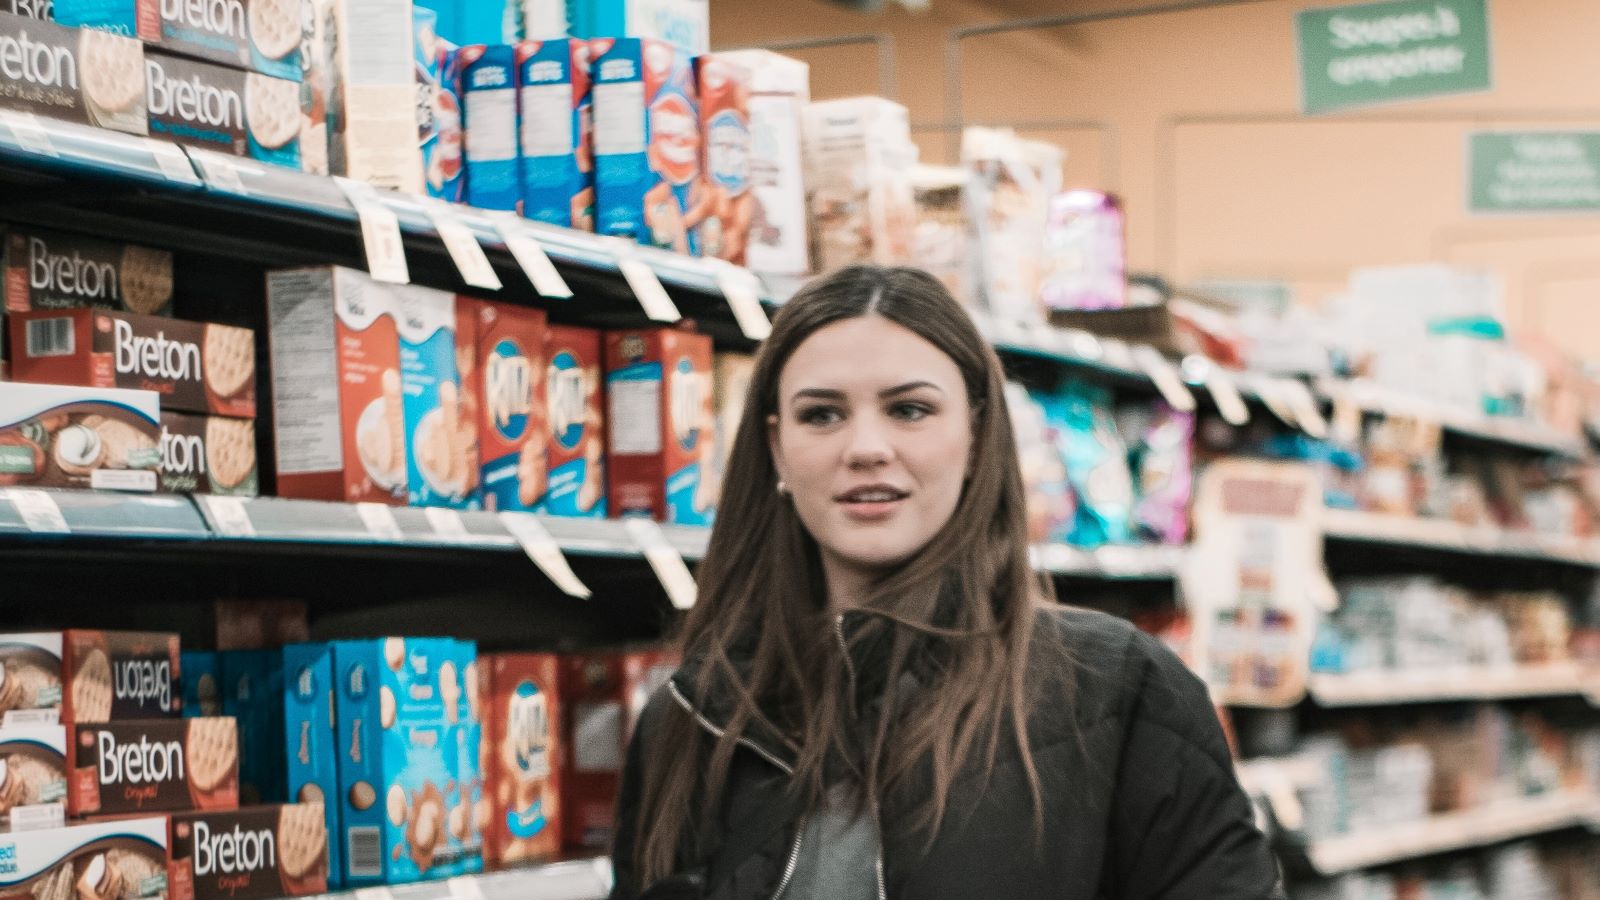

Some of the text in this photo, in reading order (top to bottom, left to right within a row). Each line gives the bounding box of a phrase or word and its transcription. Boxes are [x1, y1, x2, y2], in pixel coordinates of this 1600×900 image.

[0, 29, 78, 90] eton
[145, 59, 244, 130] Breton
[30, 236, 118, 299] Breton
[114, 318, 201, 382] Breton
[160, 424, 205, 474] ton
[114, 659, 171, 712] Breton
[98, 730, 184, 785] Breton
[193, 820, 275, 876] Breton
